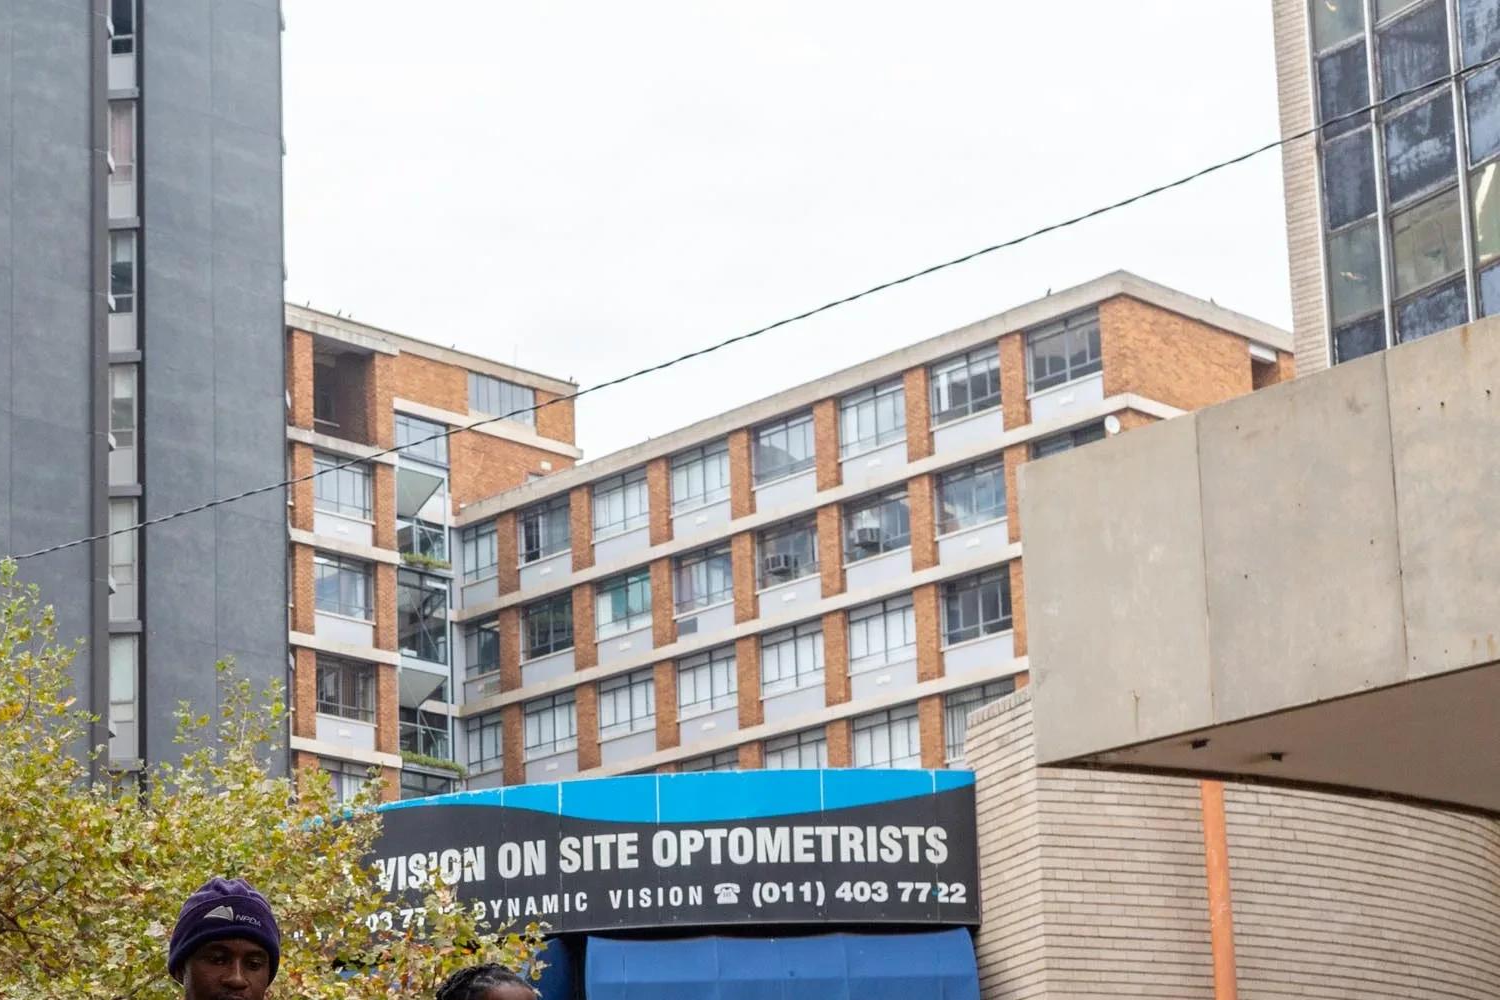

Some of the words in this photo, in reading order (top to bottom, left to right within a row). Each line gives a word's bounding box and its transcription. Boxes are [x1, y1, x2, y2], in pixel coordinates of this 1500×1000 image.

[376, 846, 485, 892] VISION
[498, 840, 546, 880] ON
[559, 832, 639, 873] SITE
[651, 826, 949, 867] OPTOMETRISTS
[474, 891, 588, 920] DYNAMIC
[609, 886, 703, 910] VISION
[752, 880, 825, 907] (011)
[835, 881, 889, 903] 403
[897, 882, 967, 903] 7722
